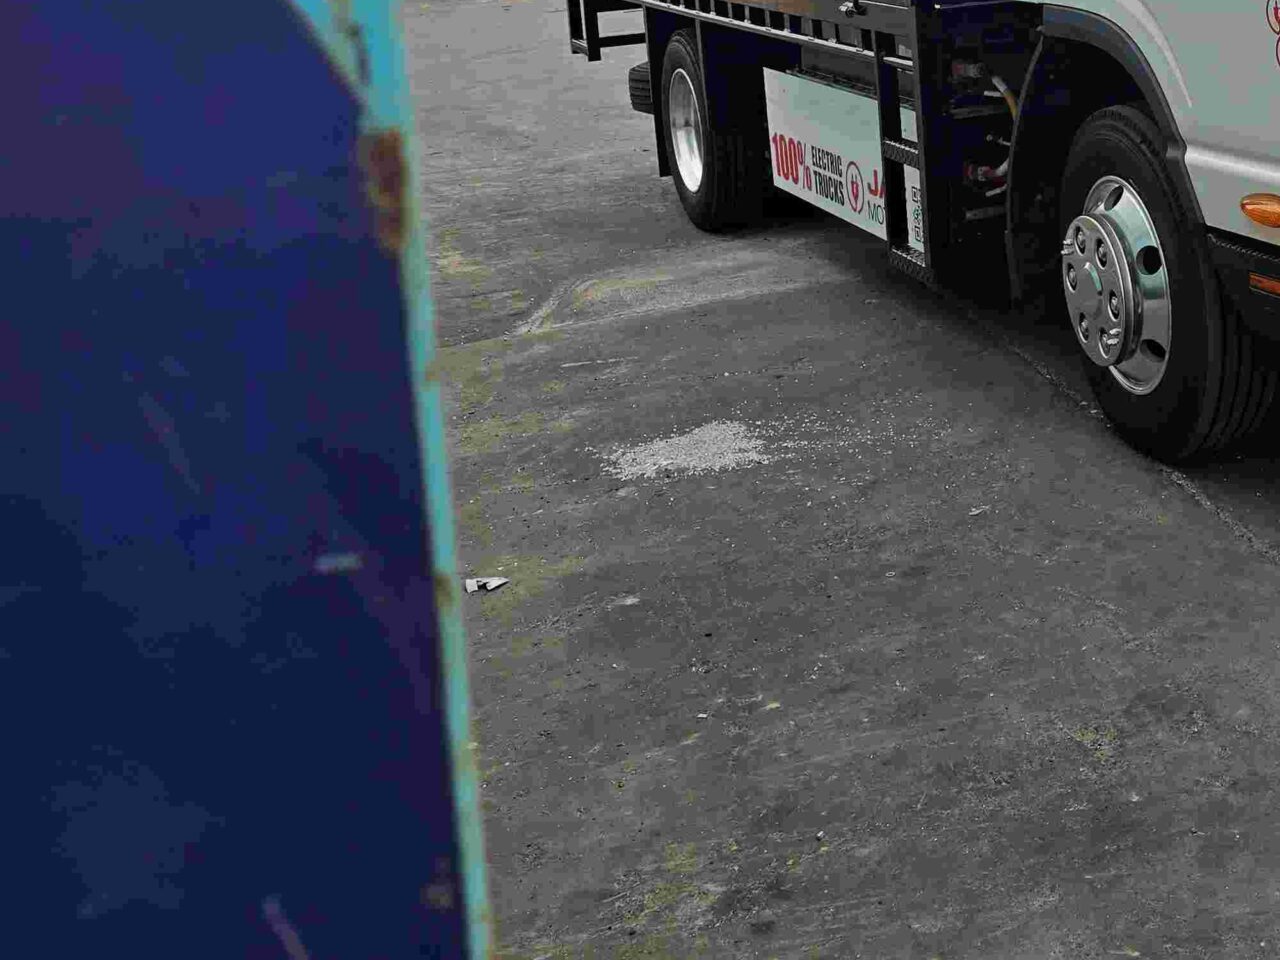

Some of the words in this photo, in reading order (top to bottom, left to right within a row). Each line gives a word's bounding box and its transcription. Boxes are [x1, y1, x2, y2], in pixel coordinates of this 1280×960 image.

[772, 132, 812, 192] 100%
[811, 145, 843, 178] ELECTRIC
[813, 170, 845, 207] TRUCKS
